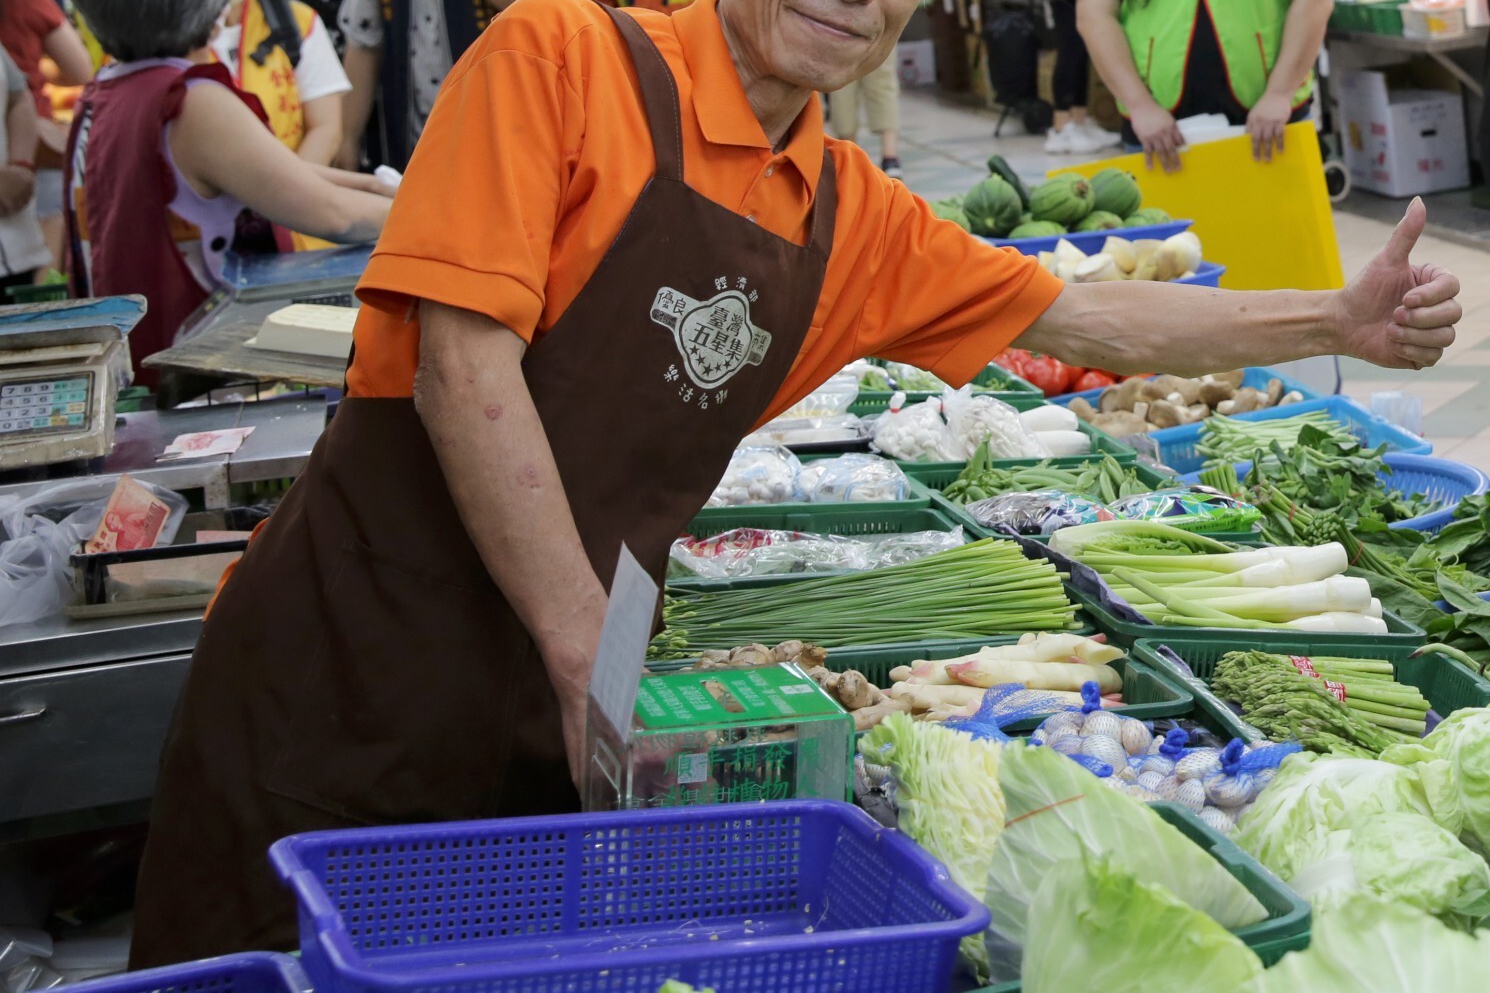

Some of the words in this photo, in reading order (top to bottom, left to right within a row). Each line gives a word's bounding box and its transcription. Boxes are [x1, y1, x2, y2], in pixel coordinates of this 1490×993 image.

[658, 289, 687, 316] 優良
[706, 305, 746, 337] 臺灣
[688, 321, 745, 362] 五星集
